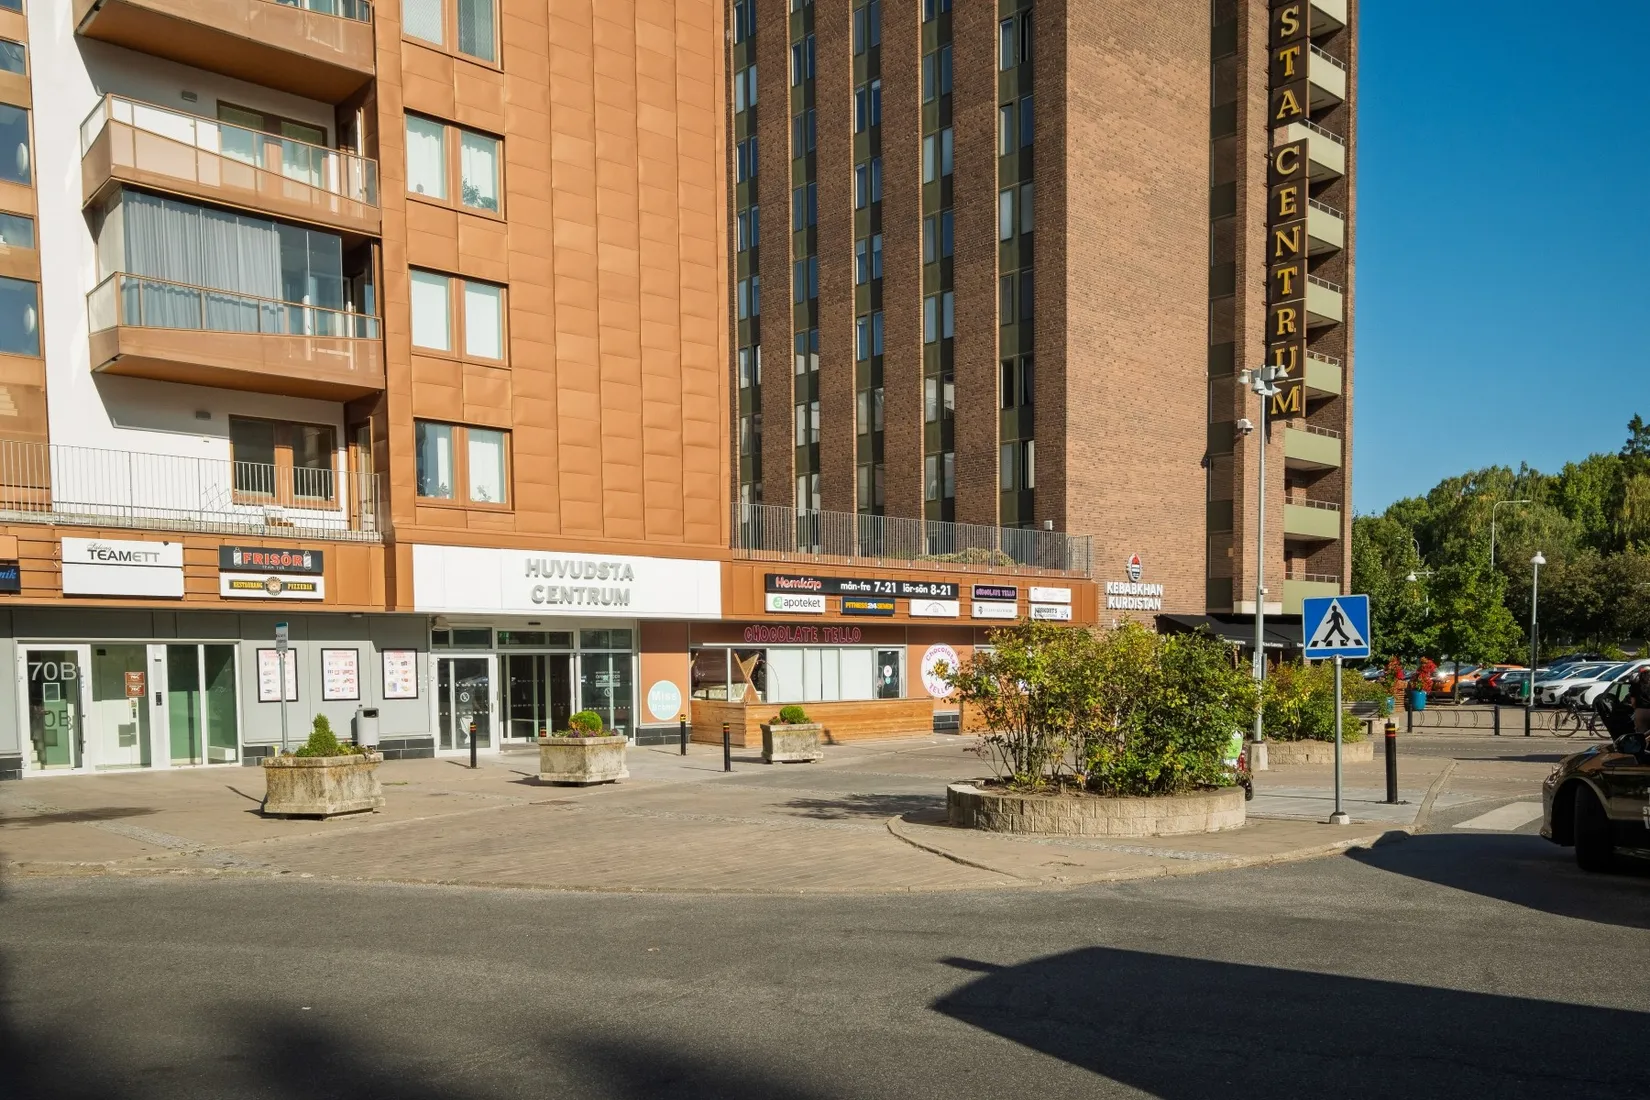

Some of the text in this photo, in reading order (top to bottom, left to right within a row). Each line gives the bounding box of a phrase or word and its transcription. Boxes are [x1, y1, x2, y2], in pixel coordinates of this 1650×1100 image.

[1271, 147, 1300, 415] CENTRUM
[243, 552, 303, 567] FRISÖR
[525, 558, 634, 581] HUVUDSTA
[775, 576, 951, 595] Hemköp mån-fre 7-21 lör-sön 8-21
[1105, 582, 1163, 596] KEBABKHAN
[531, 585, 630, 606] CENTRUM
[784, 598, 821, 608] apoteket
[1106, 596, 1161, 611] KURDISTAN
[744, 625, 861, 643] CHOCOLATE TELLO
[28, 661, 77, 681] 70B
